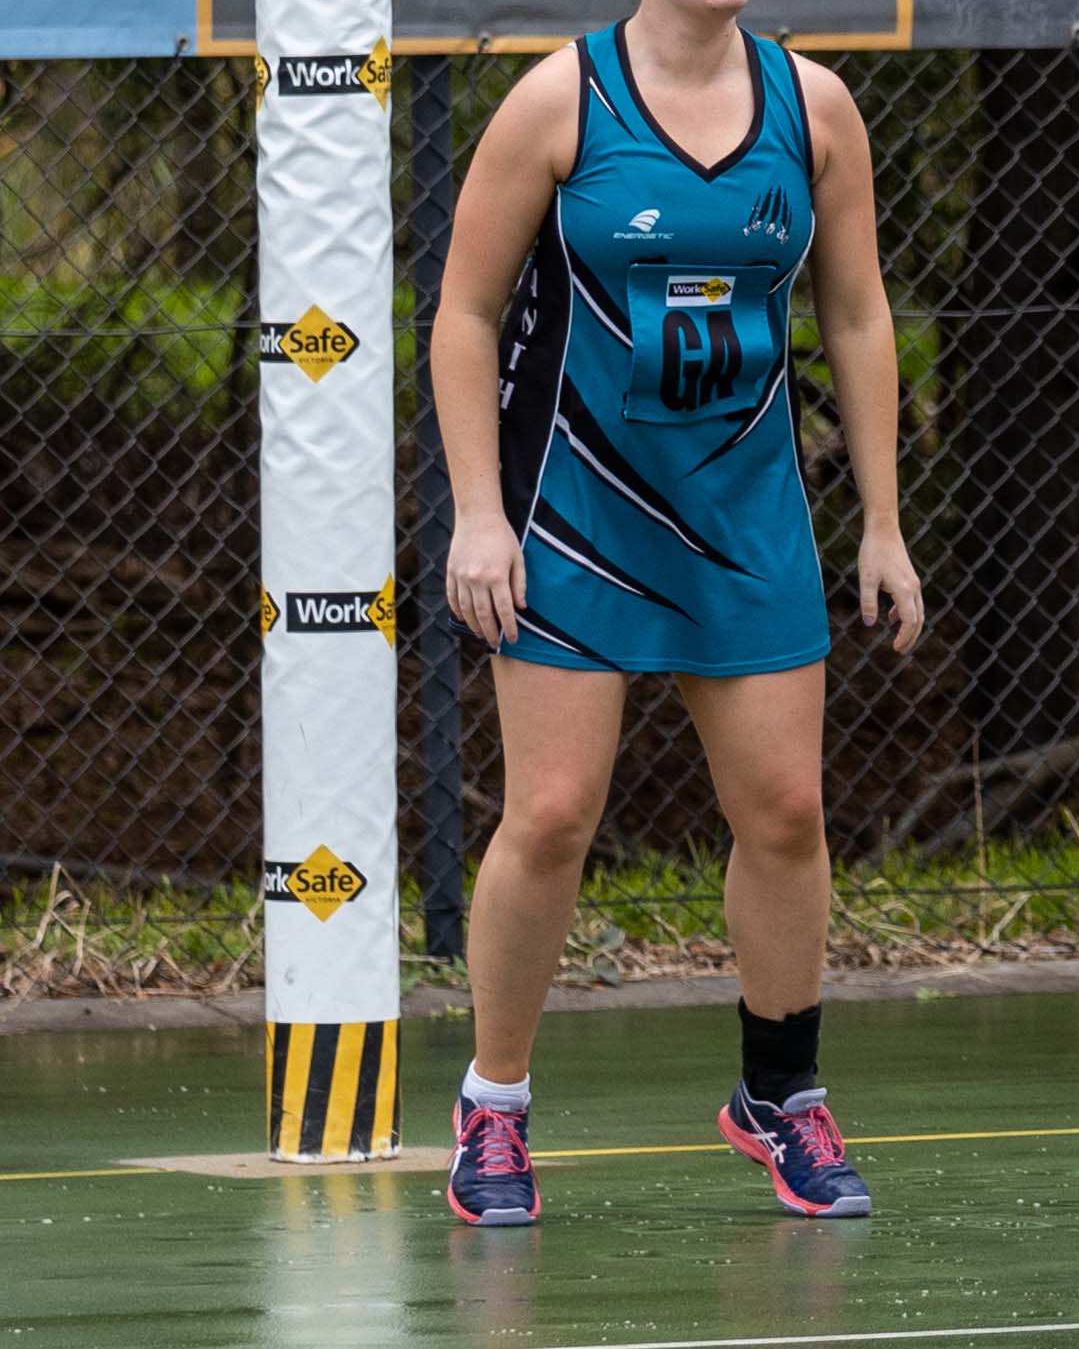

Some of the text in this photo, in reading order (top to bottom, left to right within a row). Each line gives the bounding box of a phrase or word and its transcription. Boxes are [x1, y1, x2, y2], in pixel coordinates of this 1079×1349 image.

[286, 57, 391, 87] WorkSaf
[673, 282, 727, 295] WorkSafe
[260, 327, 346, 353] orkSafe
[660, 310, 743, 412] GA
[296, 596, 395, 623] WorkSa
[265, 866, 353, 893] orkSafe
